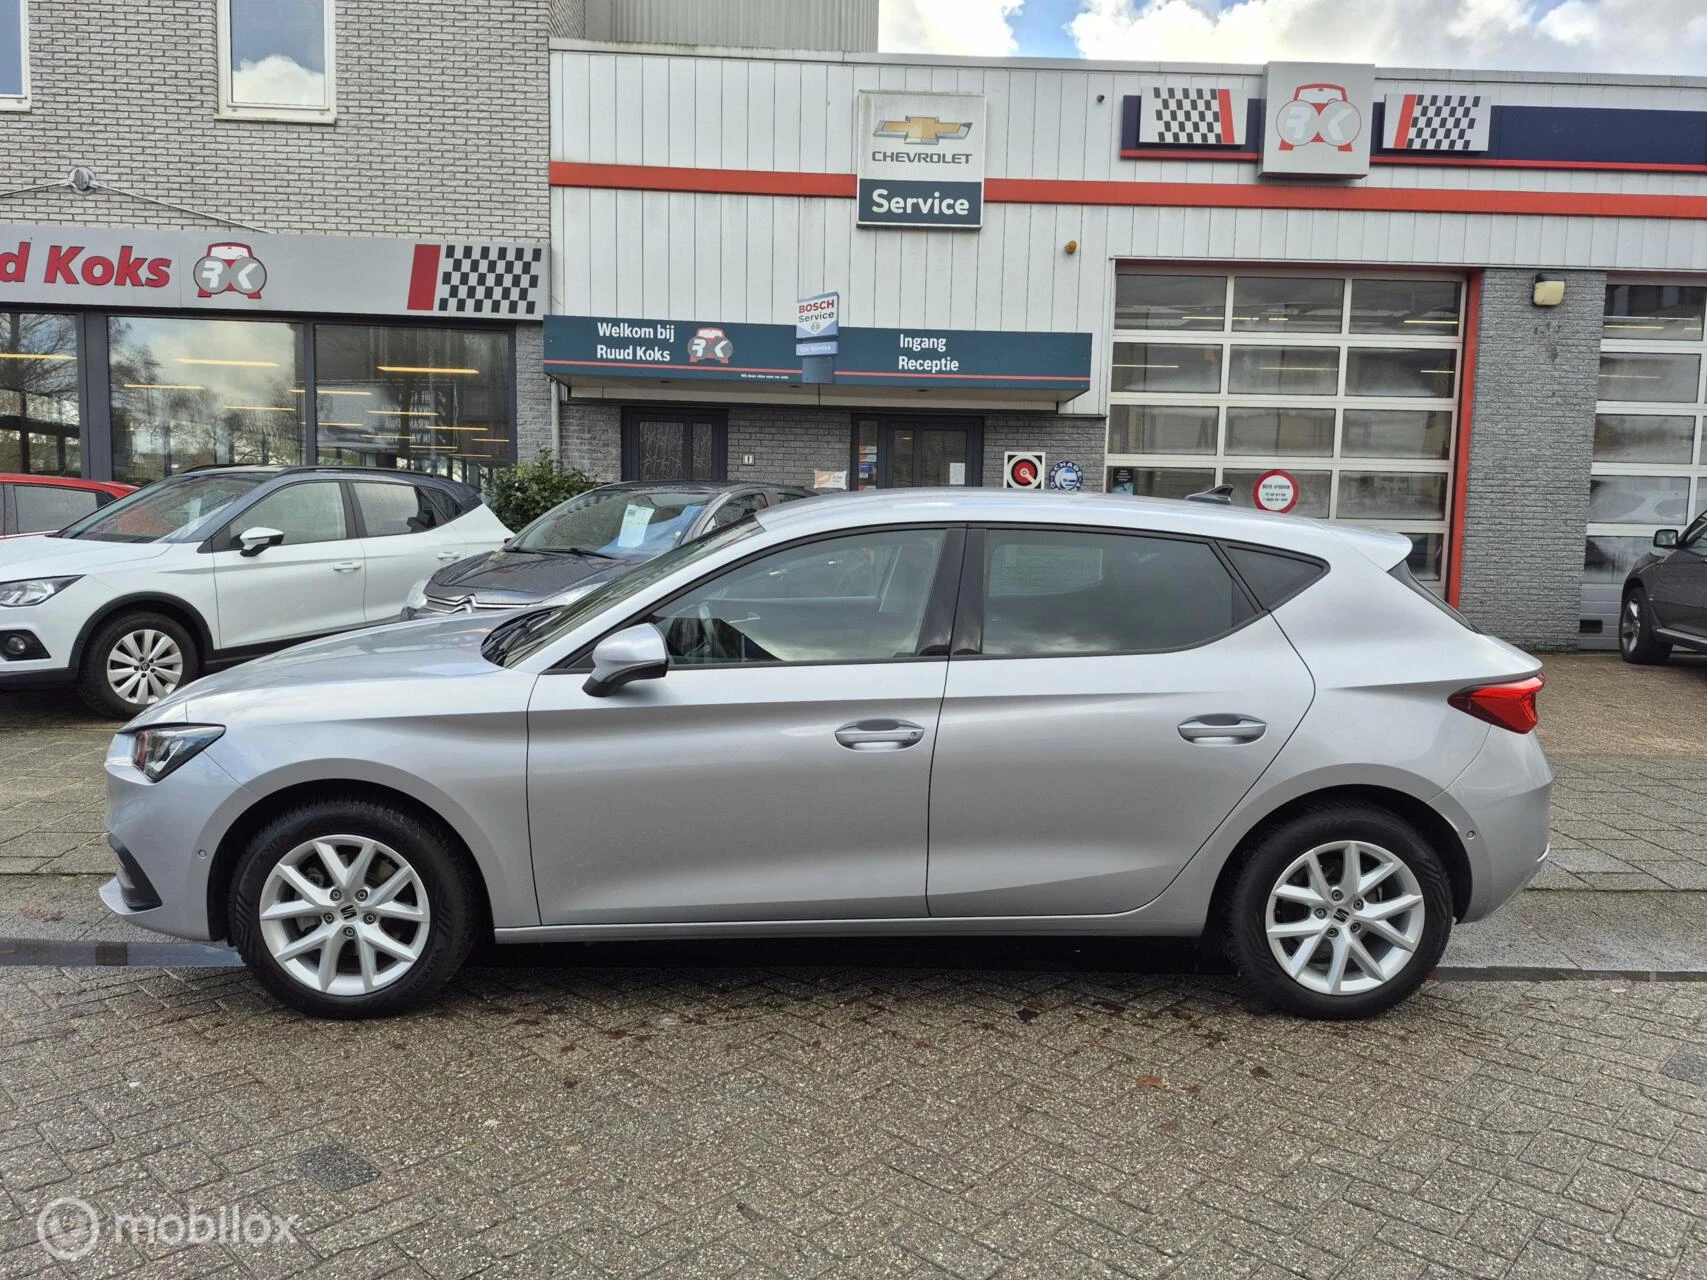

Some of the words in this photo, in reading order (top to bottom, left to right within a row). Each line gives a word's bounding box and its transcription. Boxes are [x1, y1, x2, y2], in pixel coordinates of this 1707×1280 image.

[872, 150, 972, 164] CHEVROLET
[871, 188, 970, 216] Service
[44, 245, 172, 288] Koks
[798, 299, 835, 314] BOSCH
[798, 311, 835, 323] Service
[597, 322, 654, 339] Welkom
[657, 324, 675, 342] bij
[900, 333, 947, 352] Ingang
[596, 344, 633, 360] Ruud
[636, 346, 671, 361] Koks
[898, 355, 960, 374] Receptie
